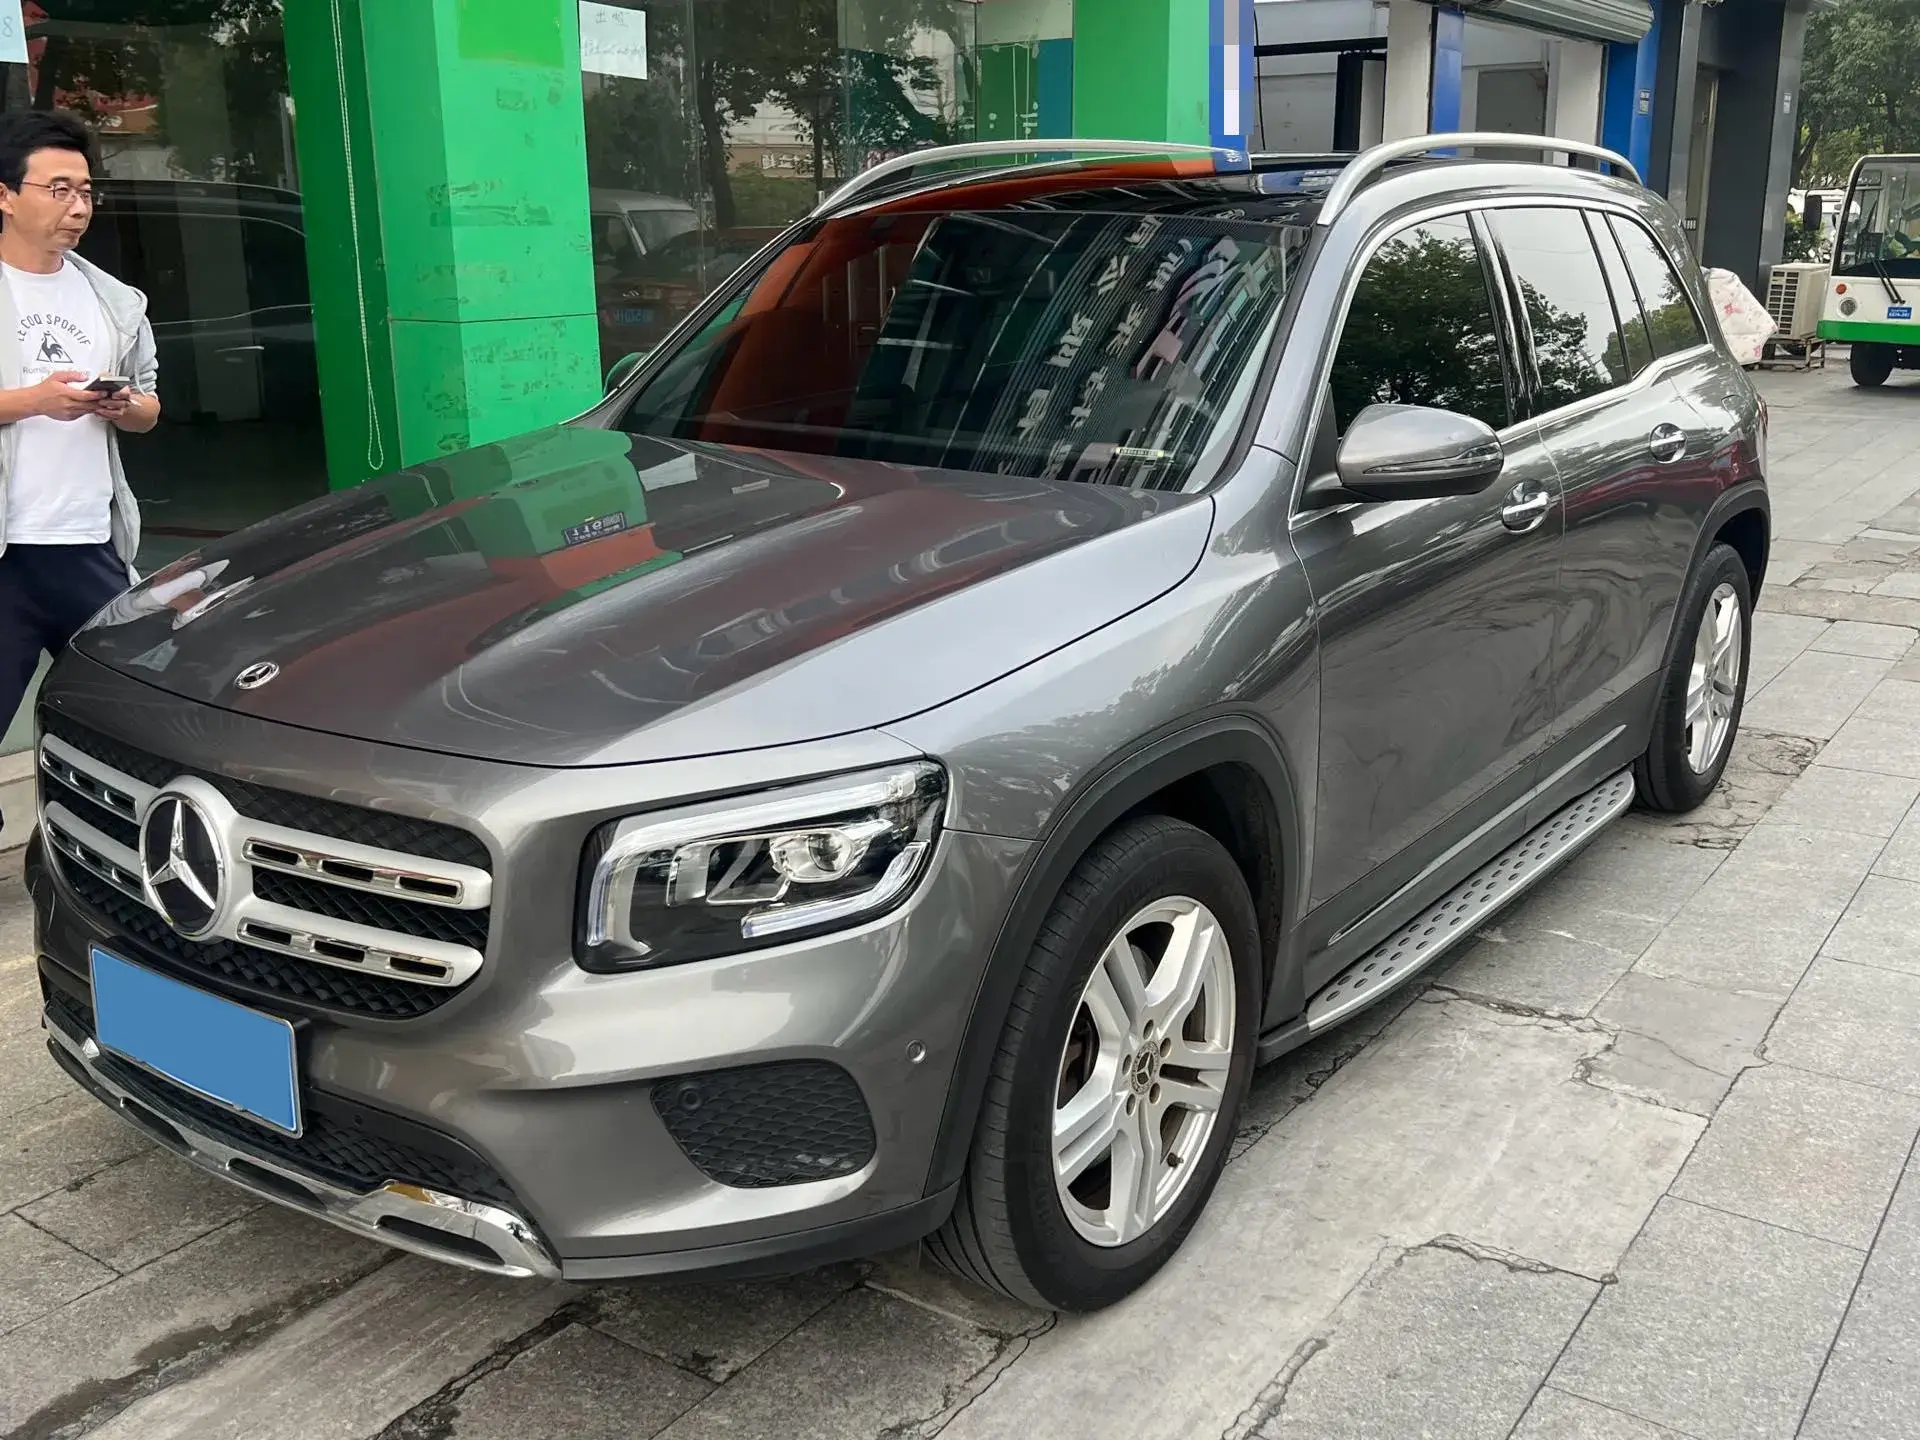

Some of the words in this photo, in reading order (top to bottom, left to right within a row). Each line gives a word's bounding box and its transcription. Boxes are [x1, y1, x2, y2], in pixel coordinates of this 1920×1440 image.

[20, 313, 43, 329] COQ
[46, 313, 91, 345] SPORTIF
[17, 329, 27, 342] LE
